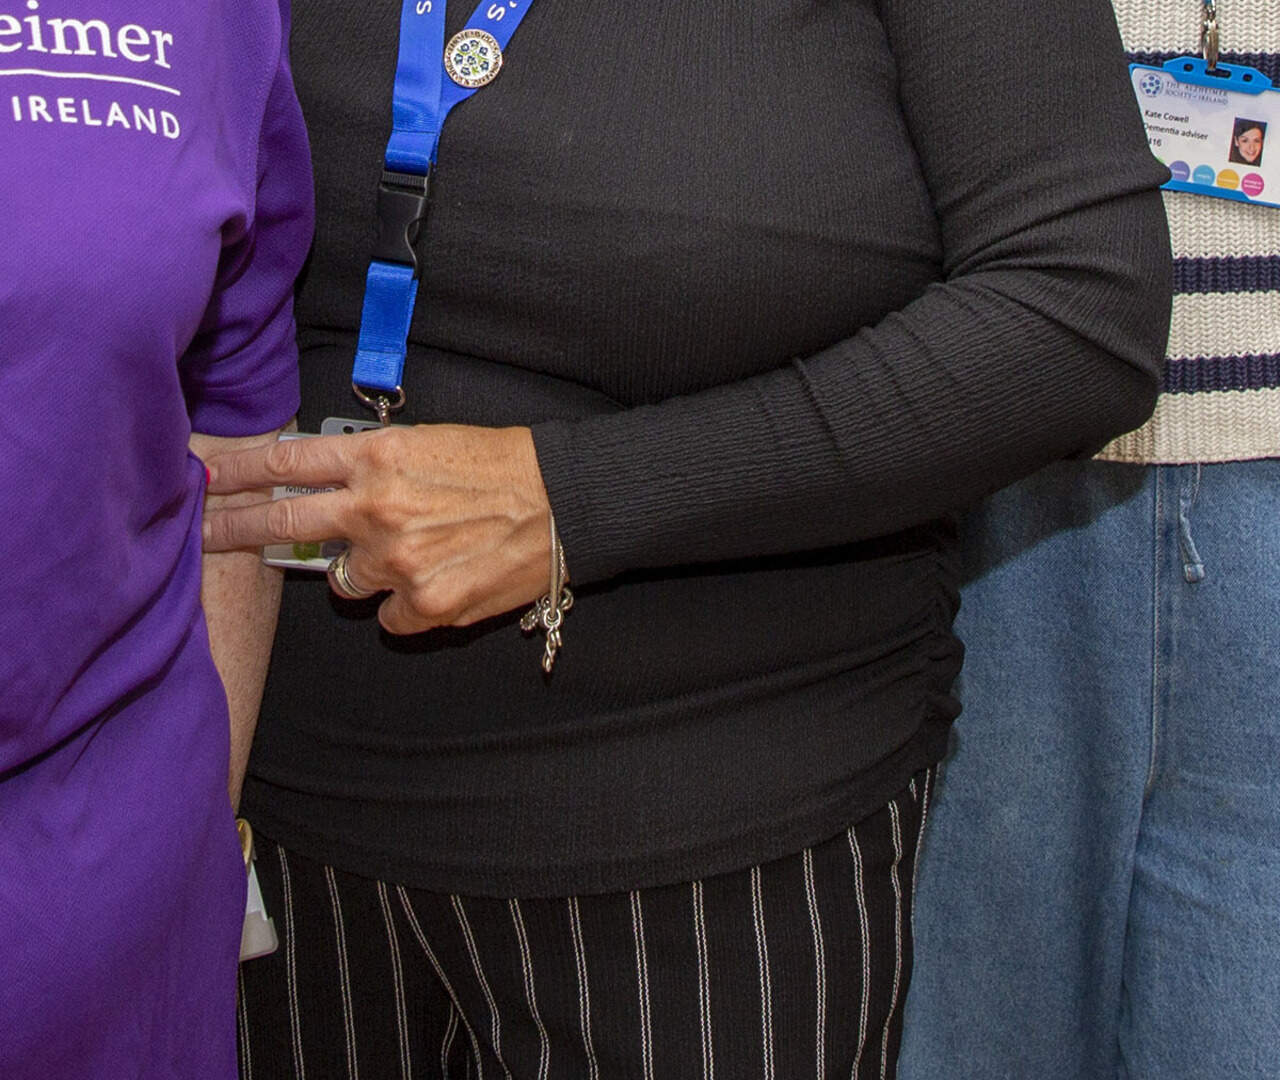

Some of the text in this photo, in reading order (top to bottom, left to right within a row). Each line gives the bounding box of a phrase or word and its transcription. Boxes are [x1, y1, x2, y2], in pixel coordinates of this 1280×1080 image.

[11, 95, 181, 140] IRELAND
[1145, 110, 1190, 123] Kate Cowell
[1144, 122, 1209, 141] Dementia adviser
